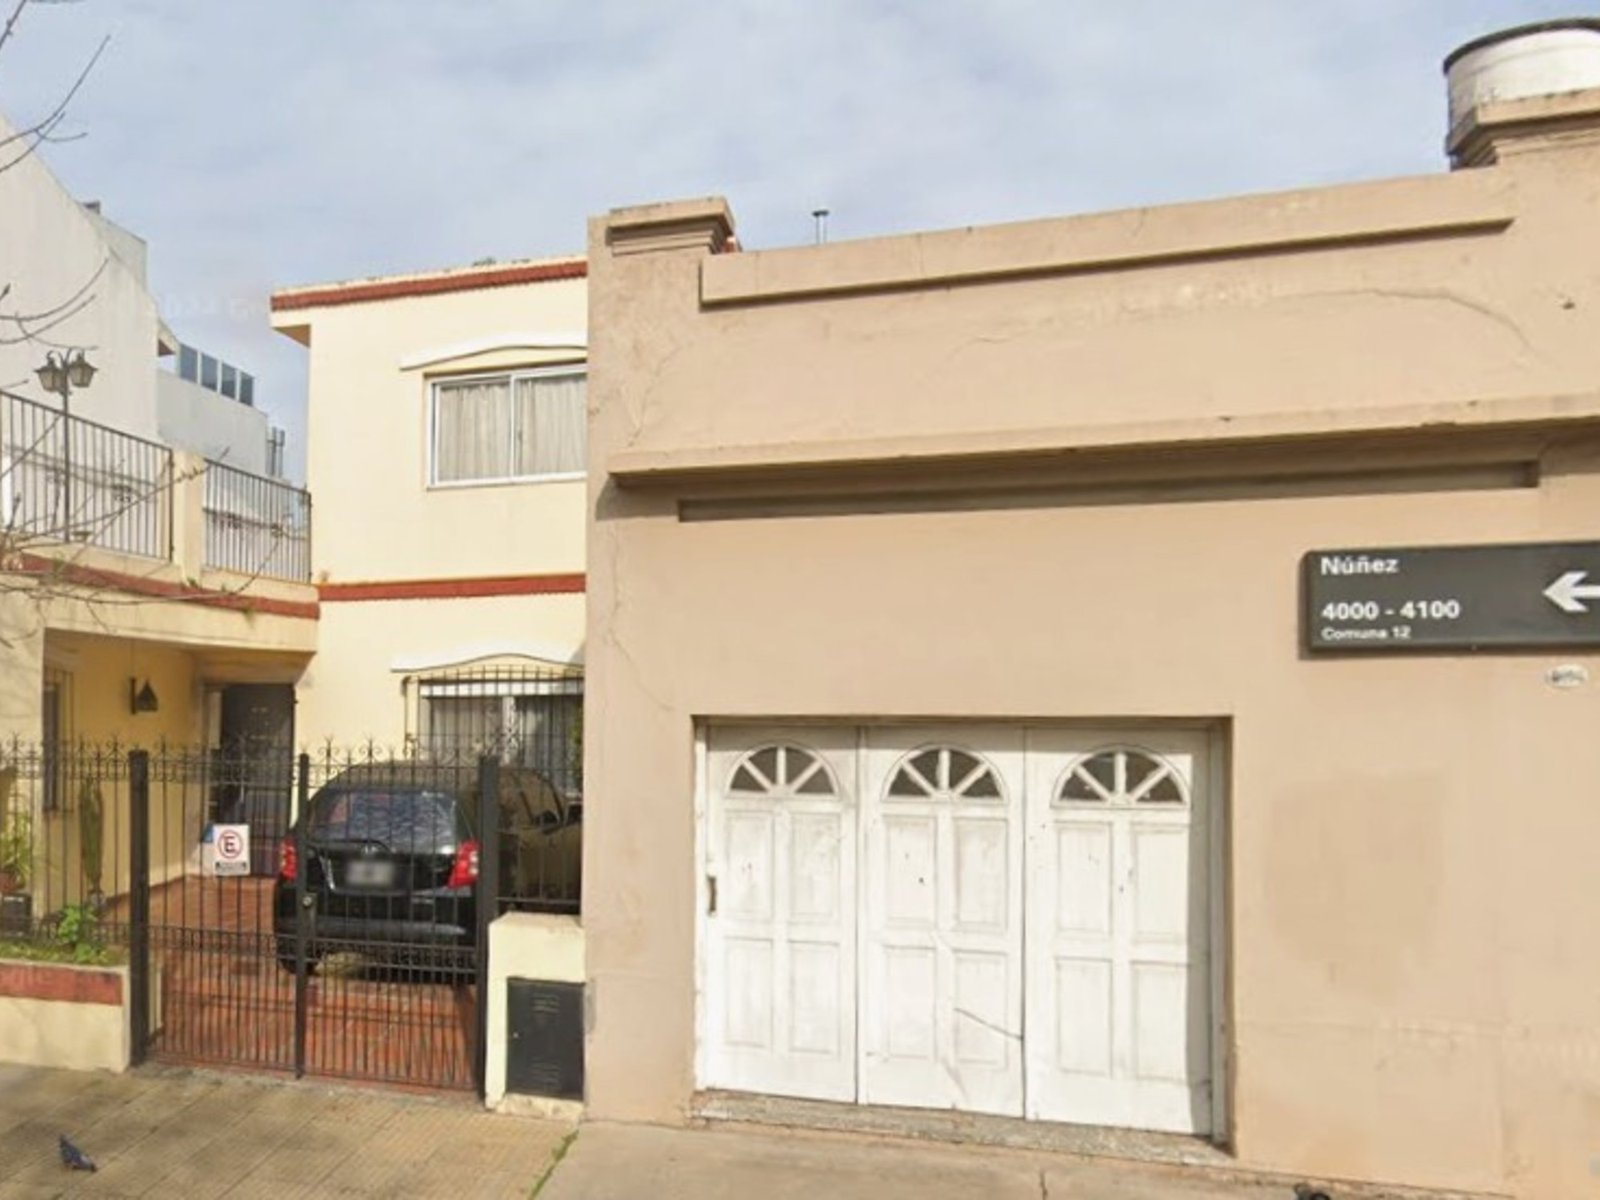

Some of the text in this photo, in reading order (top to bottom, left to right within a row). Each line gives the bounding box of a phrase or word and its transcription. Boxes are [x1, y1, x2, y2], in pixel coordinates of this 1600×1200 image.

[1320, 555, 1399, 576] Núñez
[1321, 602, 1379, 620] 4000
[1400, 600, 1461, 619] 4100
[1321, 625, 1411, 640] Comuna 12
[223, 835, 237, 854] E
